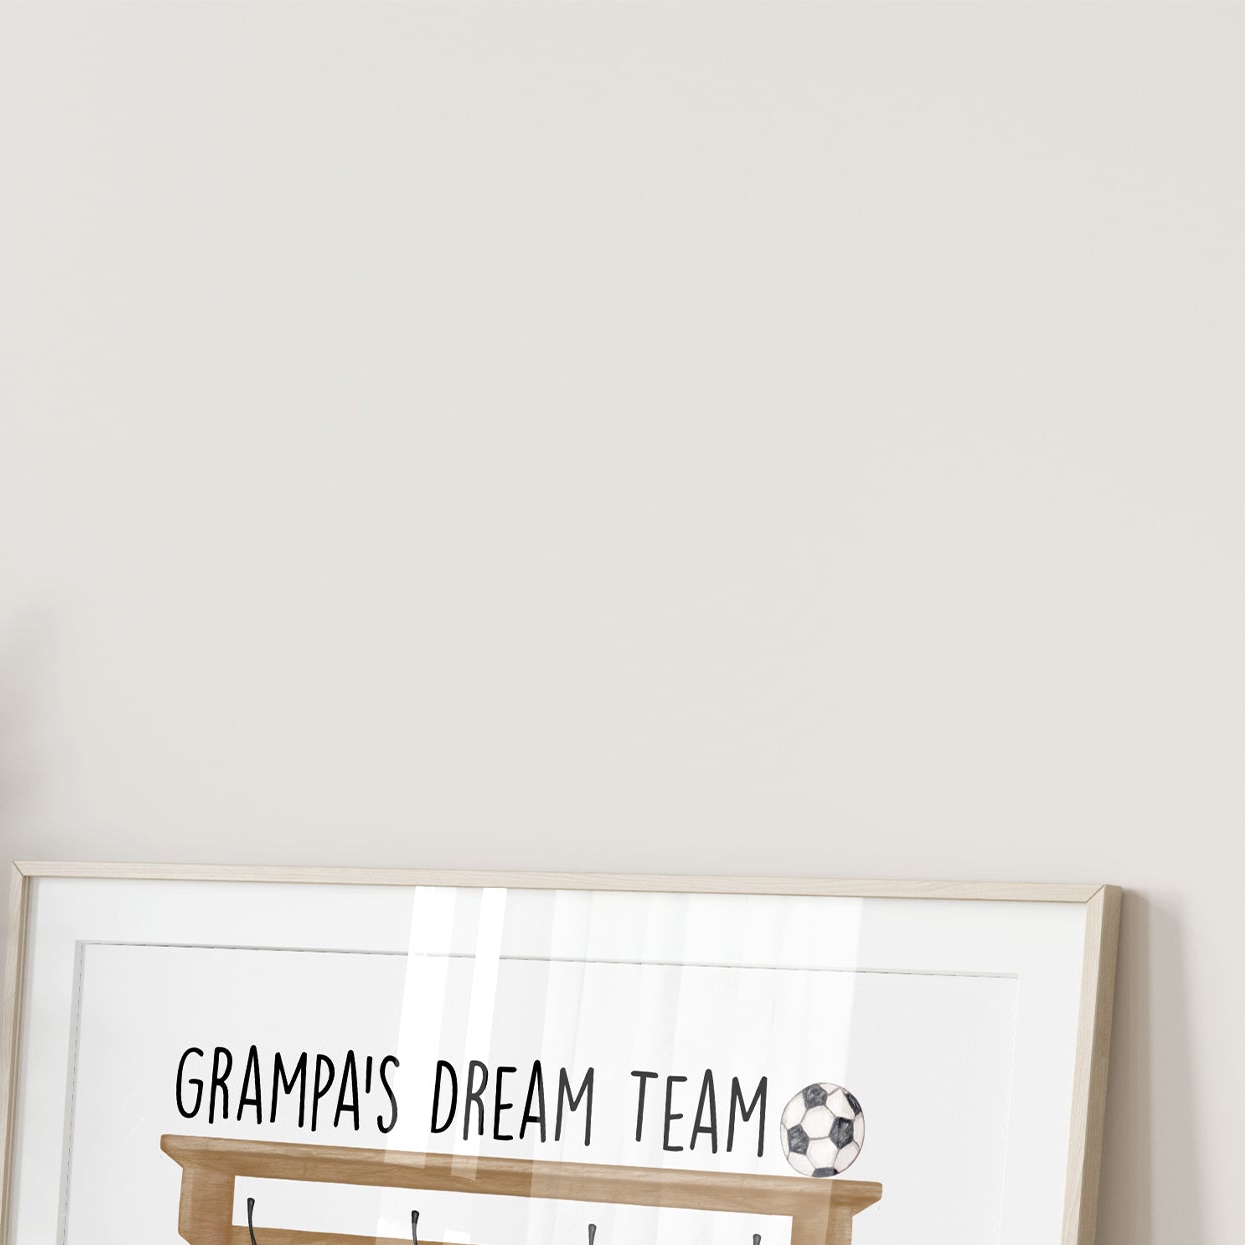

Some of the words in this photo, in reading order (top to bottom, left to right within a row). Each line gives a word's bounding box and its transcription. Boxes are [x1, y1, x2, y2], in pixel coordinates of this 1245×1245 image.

[176, 1045, 399, 1133] GRAMPA'S
[431, 1060, 594, 1146] DREAM
[631, 1069, 767, 1157] TEAM
